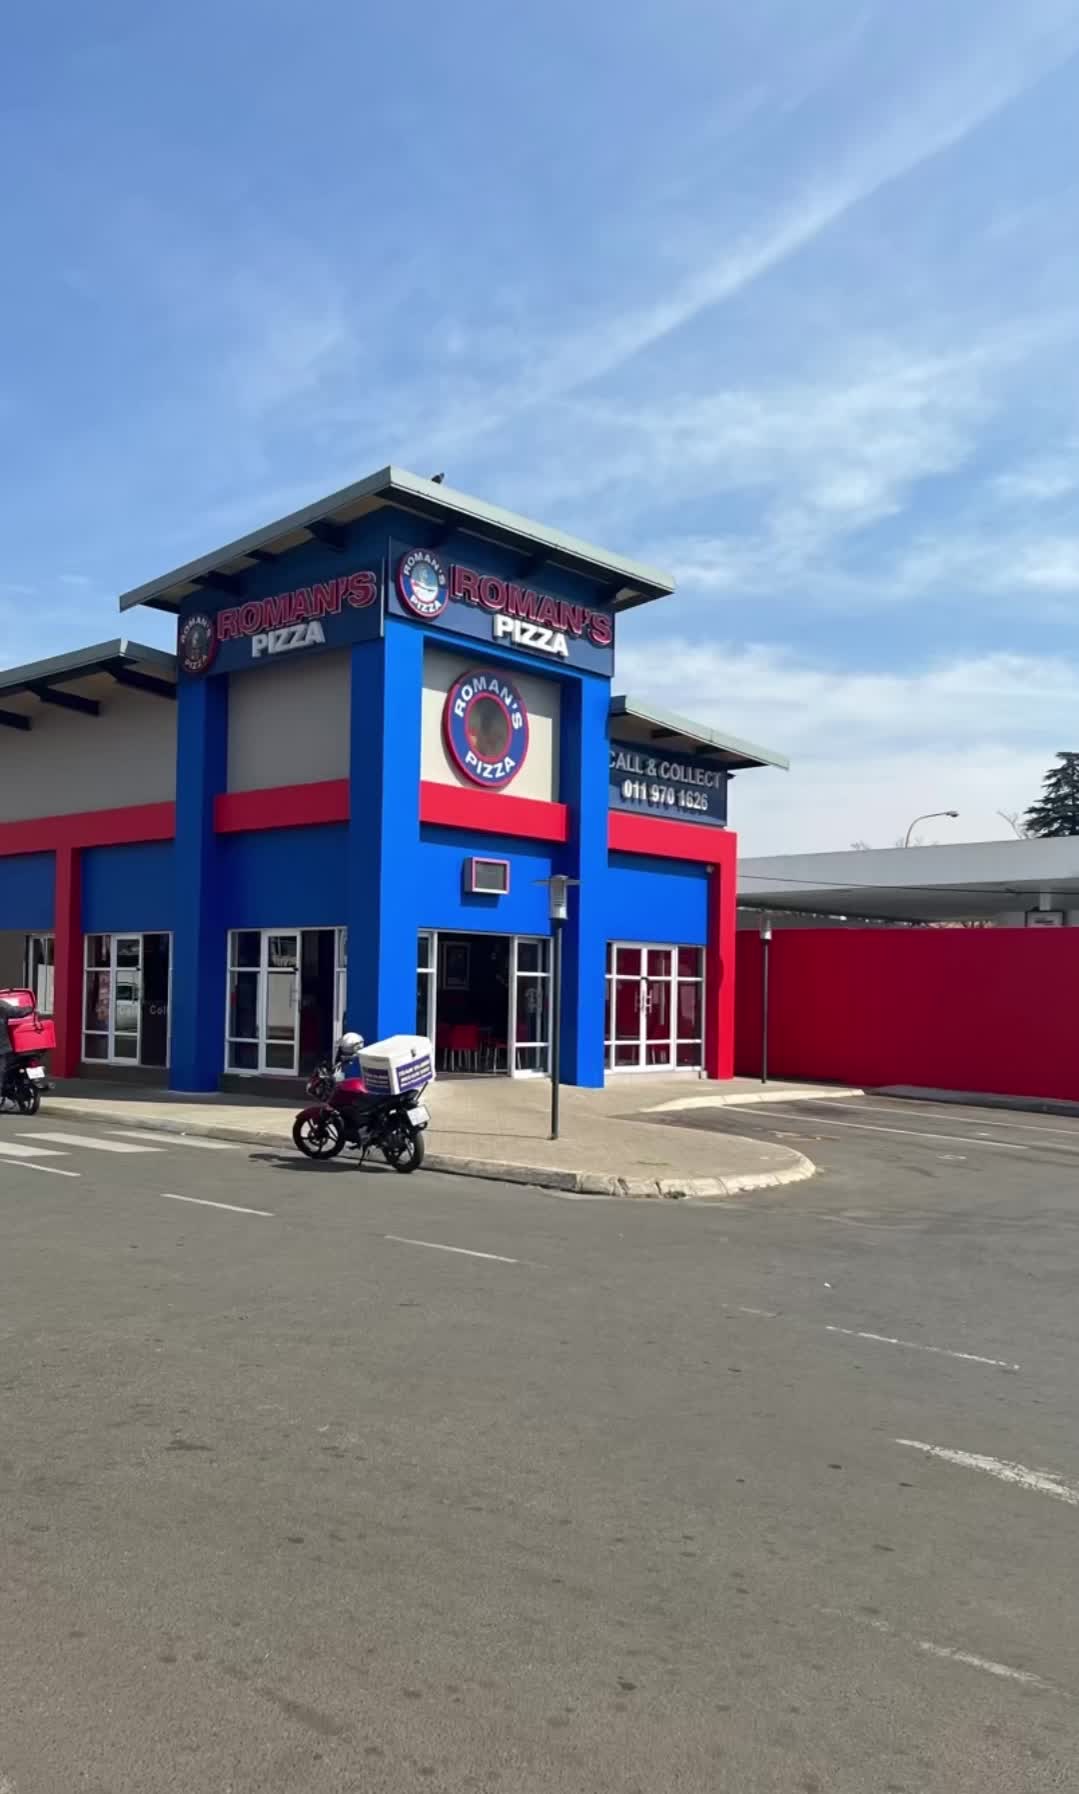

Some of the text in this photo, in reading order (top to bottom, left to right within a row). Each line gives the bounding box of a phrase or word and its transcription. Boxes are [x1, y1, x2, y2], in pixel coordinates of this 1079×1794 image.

[403, 551, 446, 585] ROMAN'S
[216, 571, 378, 641] ROMAN'S
[409, 594, 442, 613] PIZZA
[451, 564, 612, 645] ROMAN'S
[251, 621, 326, 659] PIZZA
[493, 613, 569, 658] PIZZA
[454, 676, 524, 730] ROMAN'S
[464, 750, 517, 778] PIZZA
[608, 750, 722, 790] CALL & COLLECT
[622, 778, 709, 812] 011 970 1626
